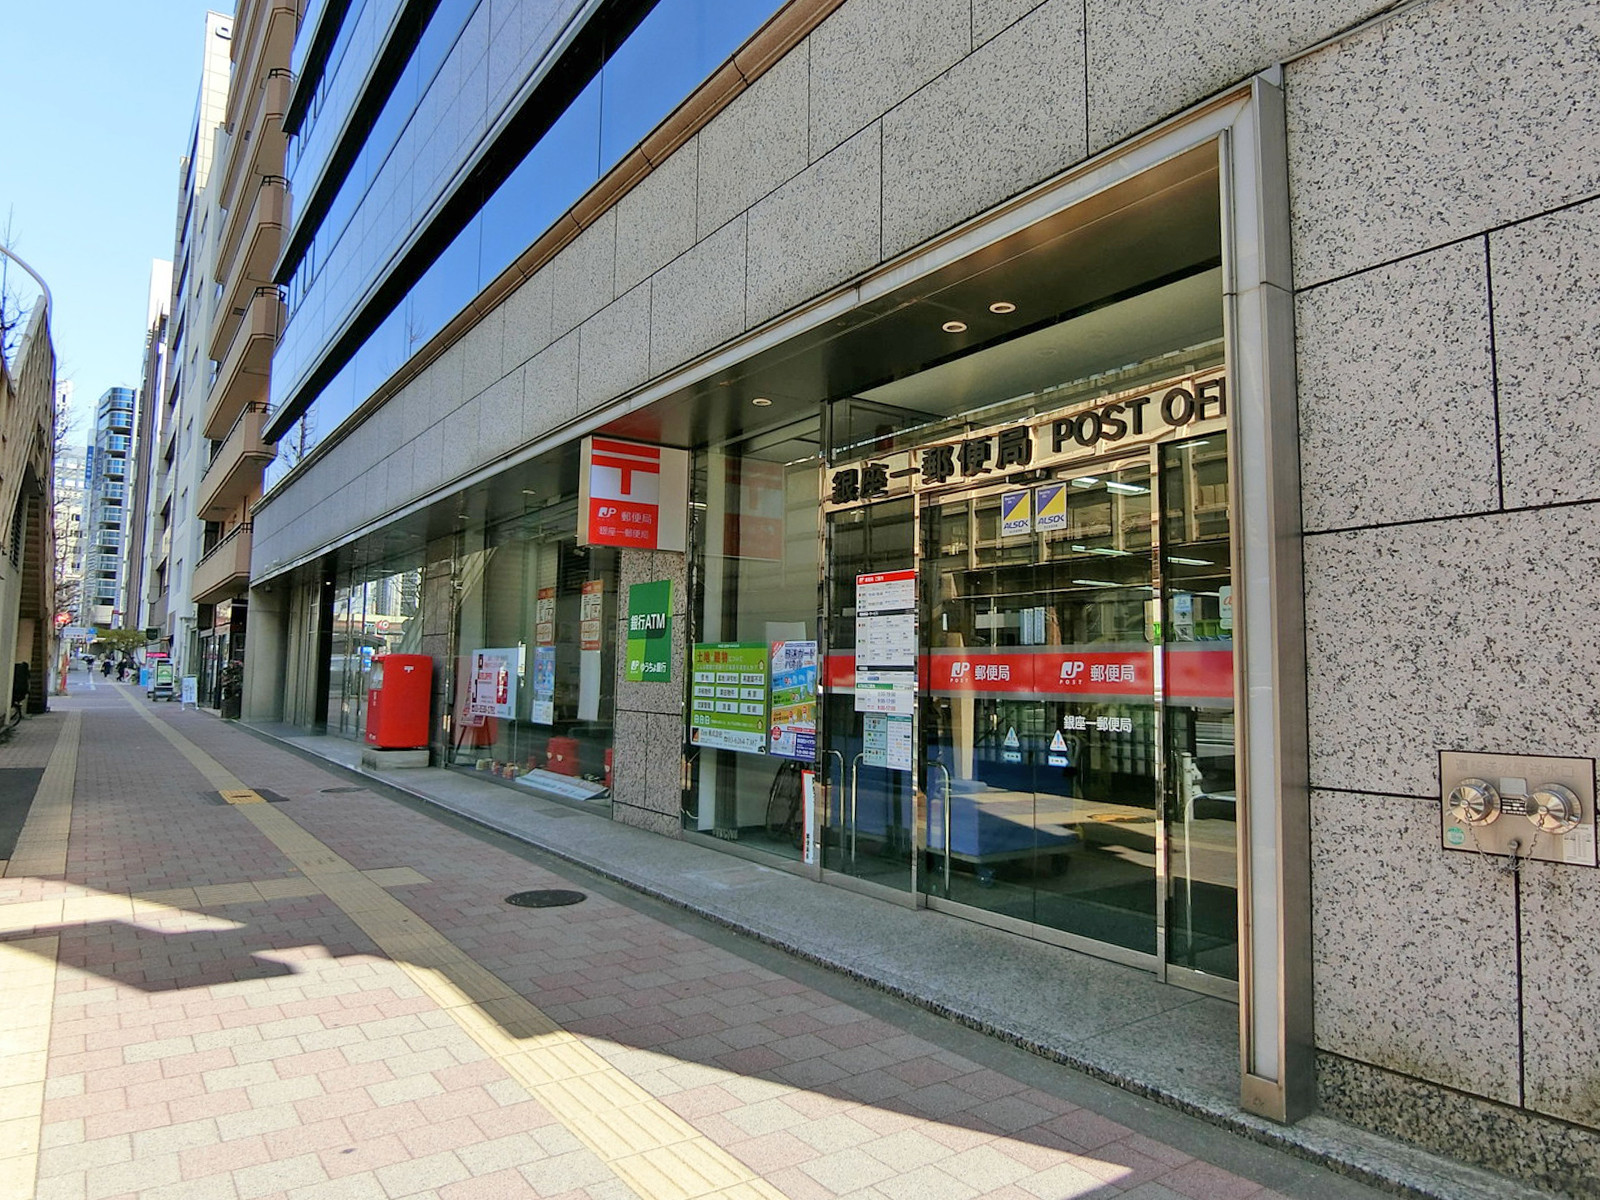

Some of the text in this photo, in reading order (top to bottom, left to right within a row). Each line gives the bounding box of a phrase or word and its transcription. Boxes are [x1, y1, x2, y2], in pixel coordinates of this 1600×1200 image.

[831, 426, 1032, 505] 銀座一郵便局
[1051, 396, 1150, 453] POST
[621, 511, 652, 524] 郵便局
[1003, 520, 1029, 529] ALSOK
[1038, 515, 1065, 525] ALSOK
[630, 612, 666, 631] 銀行ATM
[640, 662, 667, 673] ゆうちょ銀行
[975, 664, 1010, 681] 郵便局
[1090, 664, 1135, 683] 郵便局
[1063, 715, 1133, 733] 銀座一郵便局
